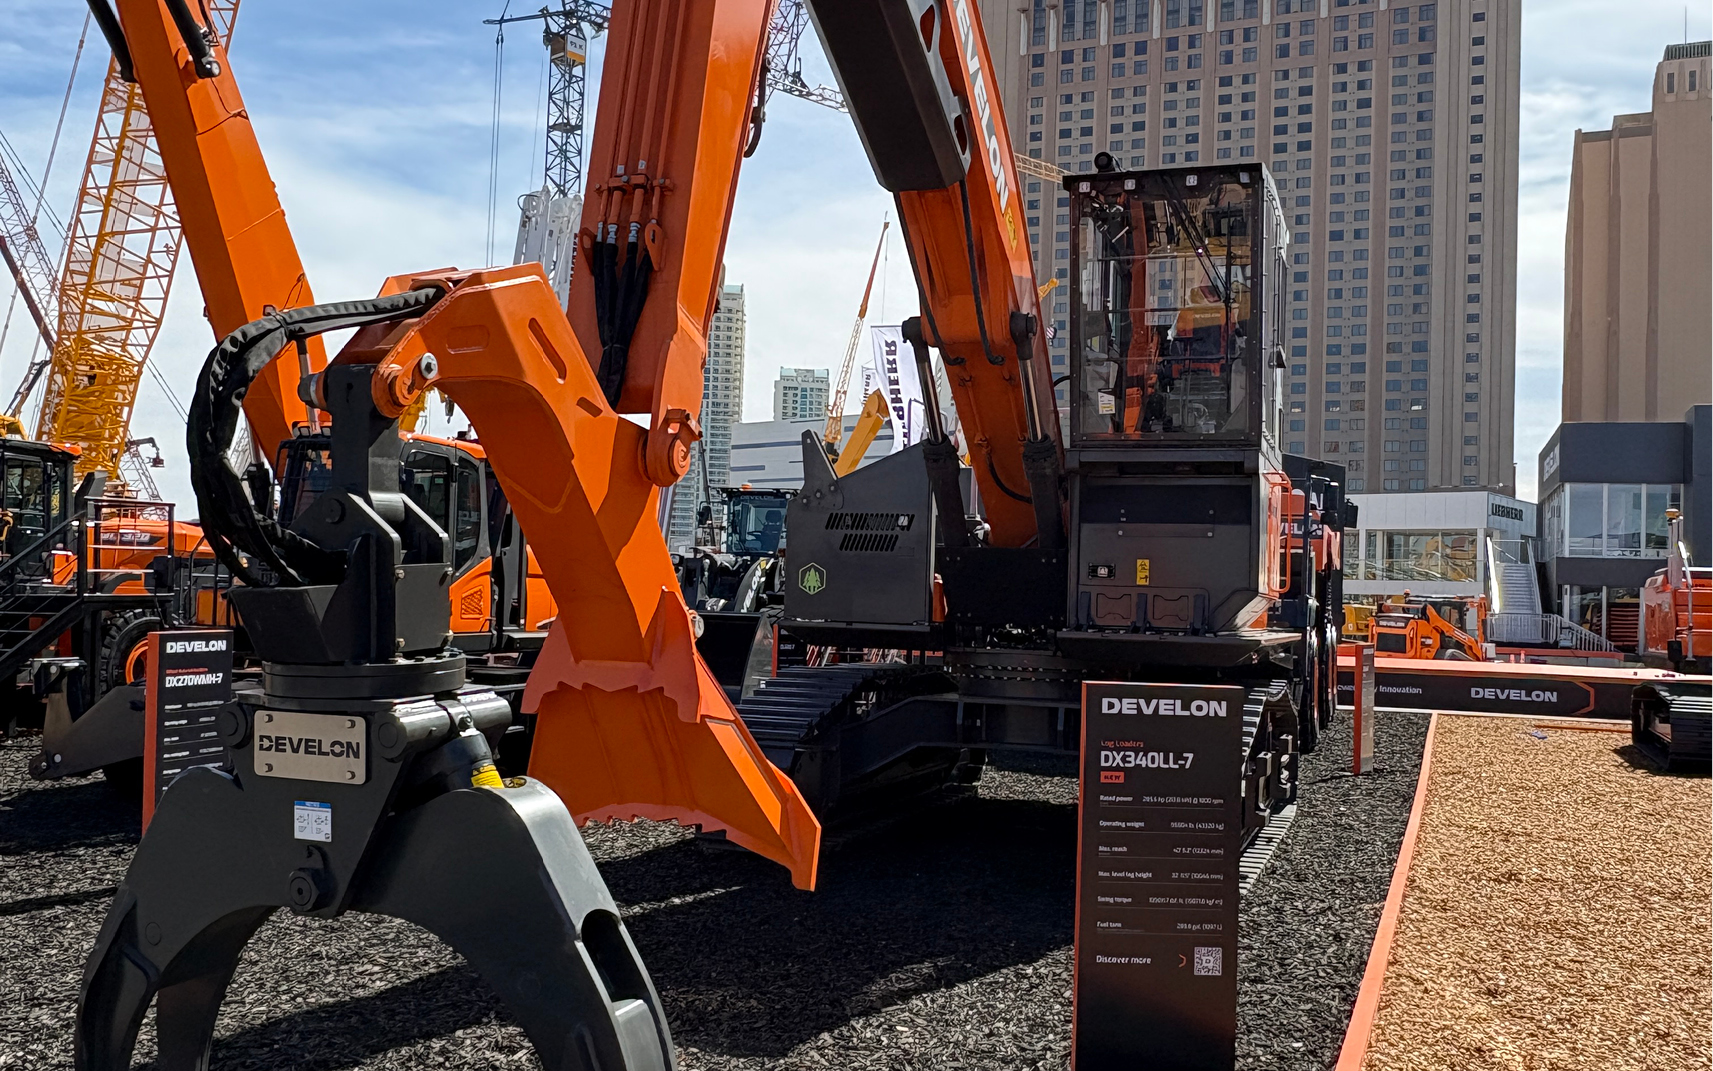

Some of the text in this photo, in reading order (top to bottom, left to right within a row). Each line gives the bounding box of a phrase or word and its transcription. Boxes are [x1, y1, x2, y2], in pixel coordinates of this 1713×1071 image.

[954, 0, 1009, 215] EVELON
[1491, 503, 1524, 522] LIEBHERR
[166, 640, 227, 654] DEVELON
[165, 672, 223, 688] DX270WMH-7
[1379, 685, 1422, 694] Innovation
[1470, 687, 1558, 702] DEVELON
[1101, 697, 1228, 718] DEVELON
[258, 735, 360, 760] DEVELON
[1100, 740, 1144, 748] Log Loaders
[1100, 750, 1195, 770] DX340LL-7
[1099, 820, 1126, 828] Operating
[1096, 955, 1152, 964] Discover more
